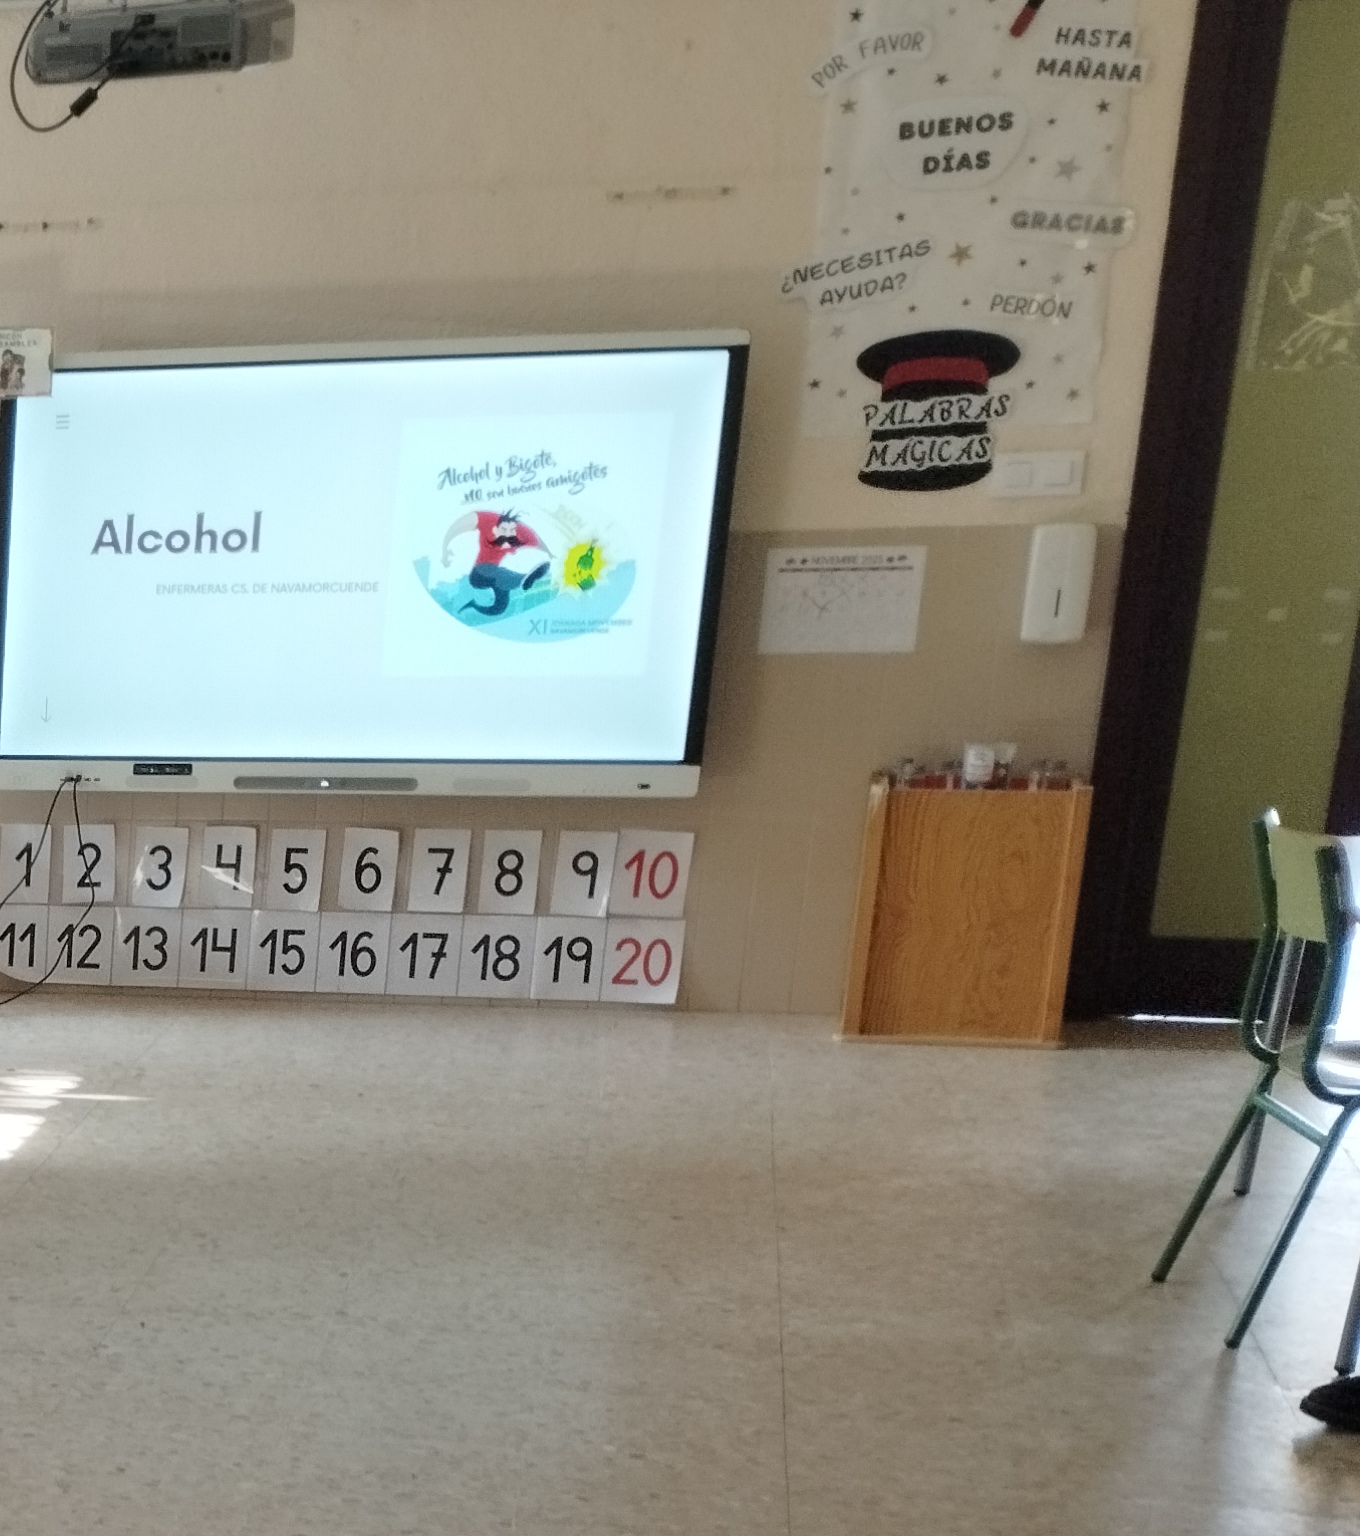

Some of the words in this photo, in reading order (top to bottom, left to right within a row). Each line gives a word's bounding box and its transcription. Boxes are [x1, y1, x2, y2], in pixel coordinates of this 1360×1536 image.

[1055, 26, 1133, 49] HASTA
[811, 54, 849, 89] POR
[858, 31, 925, 59] FAVOR
[1036, 57, 1143, 82] MAÑANA
[898, 111, 1015, 140] BUENOS
[922, 147, 991, 175] DÍAS
[1011, 210, 1126, 235] GRACIAS
[781, 239, 932, 294] ¿NECESITAS
[819, 272, 907, 306] AYUDA?
[990, 294, 1073, 319] PERDÓN
[863, 394, 1011, 427] PALABRAS
[437, 461, 491, 491] Alcohol
[495, 466, 503, 481] y
[505, 450, 557, 483] Bigote,
[546, 462, 608, 495] amigotes
[90, 510, 263, 554] Alcohol
[156, 584, 228, 595] ENFERMERAS
[252, 583, 268, 594] DE
[271, 581, 379, 594] NAVAMORCUENDE
[528, 619, 548, 635] XI
[16, 843, 32, 887] 1
[77, 843, 101, 888] 2
[146, 845, 172, 891] 3
[216, 844, 242, 890] 4
[283, 848, 309, 894] 5
[354, 847, 382, 894] 6
[428, 847, 455, 895] 7
[495, 849, 524, 896] 8
[572, 850, 599, 899] 9
[624, 850, 679, 899] 10
[0, 923, 36, 967] 11
[57, 923, 102, 969] 12
[123, 926, 168, 970] 13
[191, 928, 238, 973] 14
[259, 929, 306, 975] 15
[329, 930, 377, 977] 16
[399, 932, 449, 979] 17
[471, 934, 520, 982] 18
[543, 936, 592, 984] 19
[611, 937, 672, 986] 20
